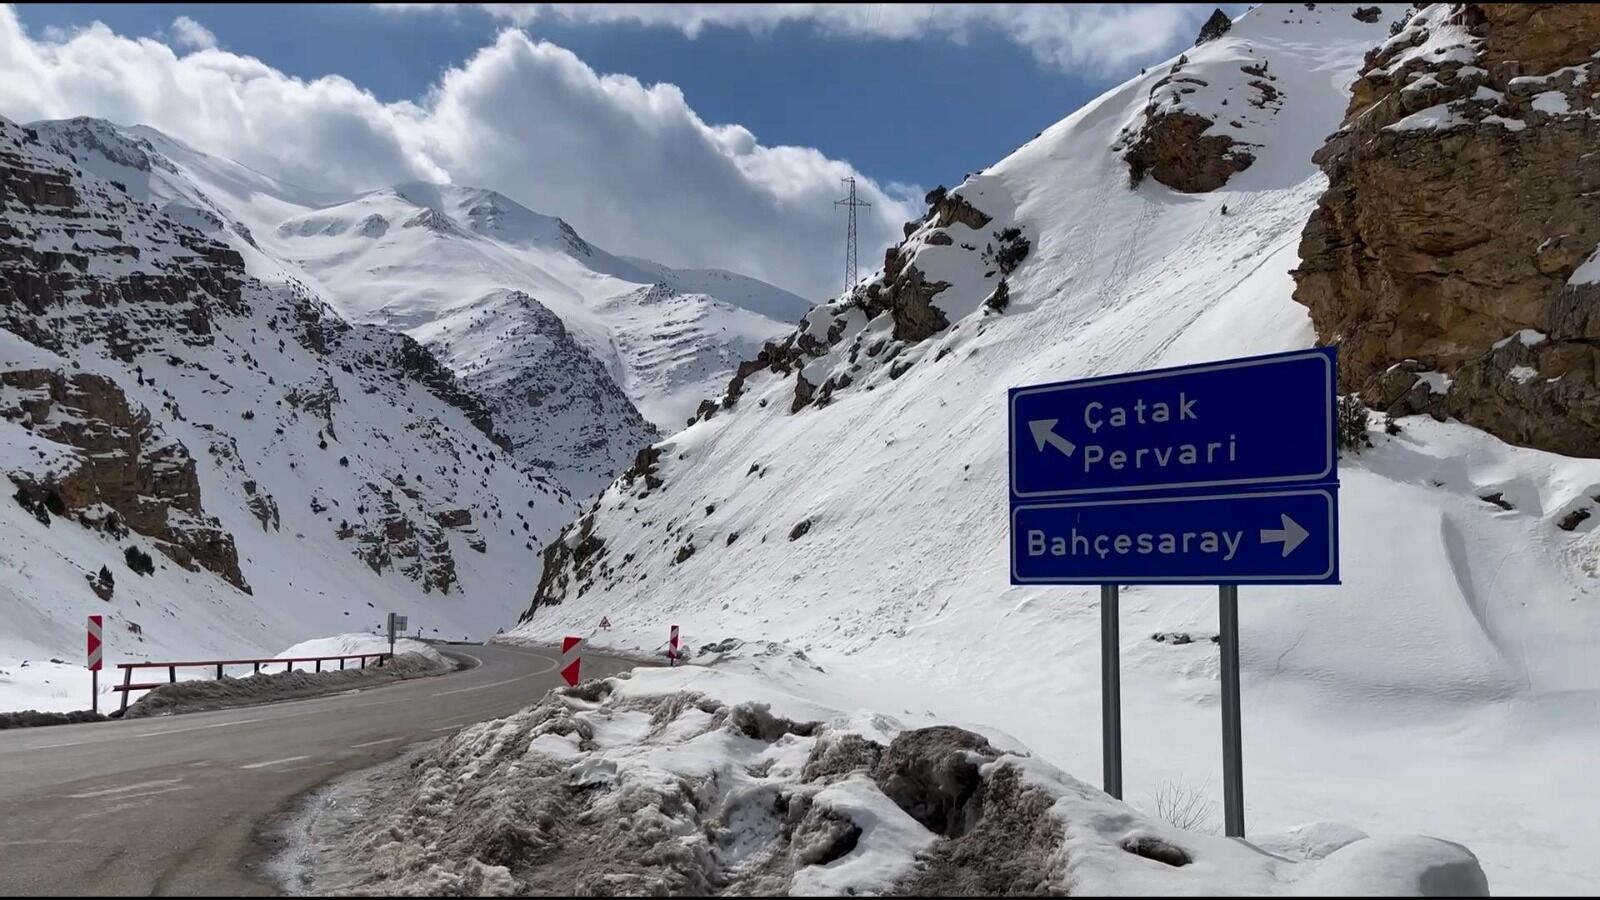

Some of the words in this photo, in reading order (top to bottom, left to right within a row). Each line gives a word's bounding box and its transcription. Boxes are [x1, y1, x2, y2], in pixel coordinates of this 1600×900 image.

[1084, 392, 1198, 433] Çatak
[1084, 434, 1236, 472] Pervari
[1028, 528, 1243, 560] Bahçesaray
